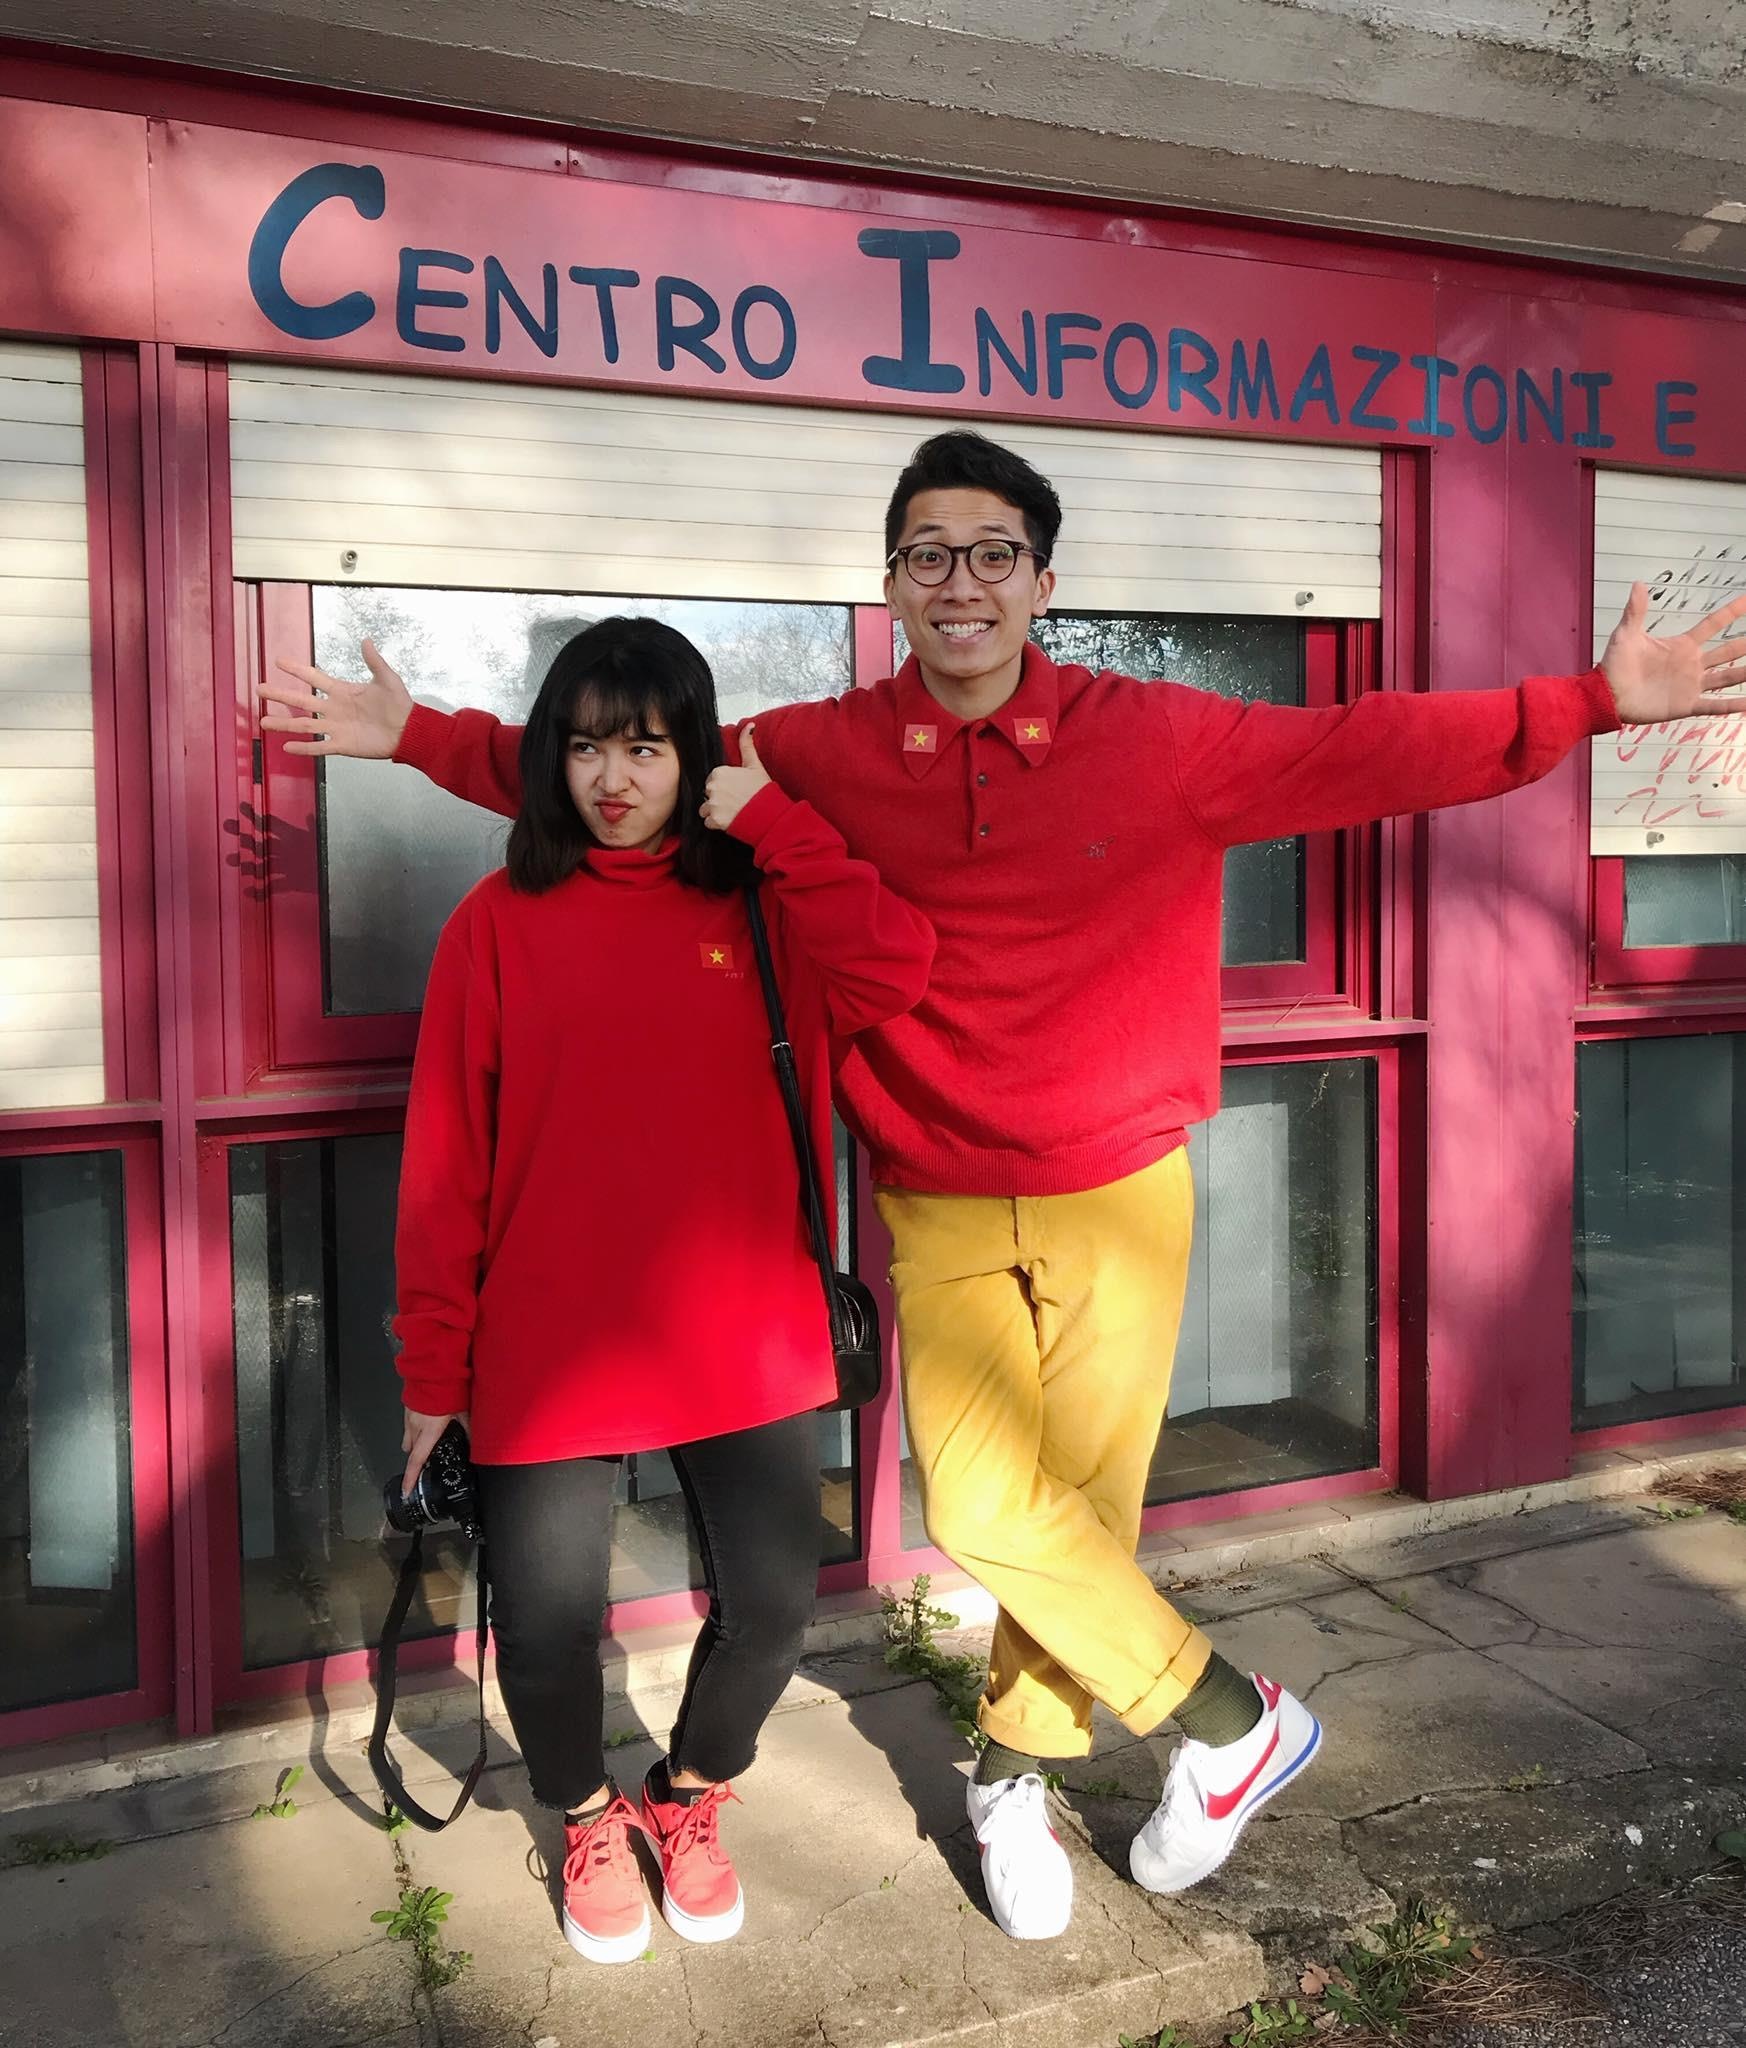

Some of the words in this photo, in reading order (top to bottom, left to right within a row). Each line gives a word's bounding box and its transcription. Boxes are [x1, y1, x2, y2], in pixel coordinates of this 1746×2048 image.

[248, 163, 797, 380] CENTRO
[857, 228, 1616, 449] INFORMAZIONI
[1655, 381, 1698, 457] E
